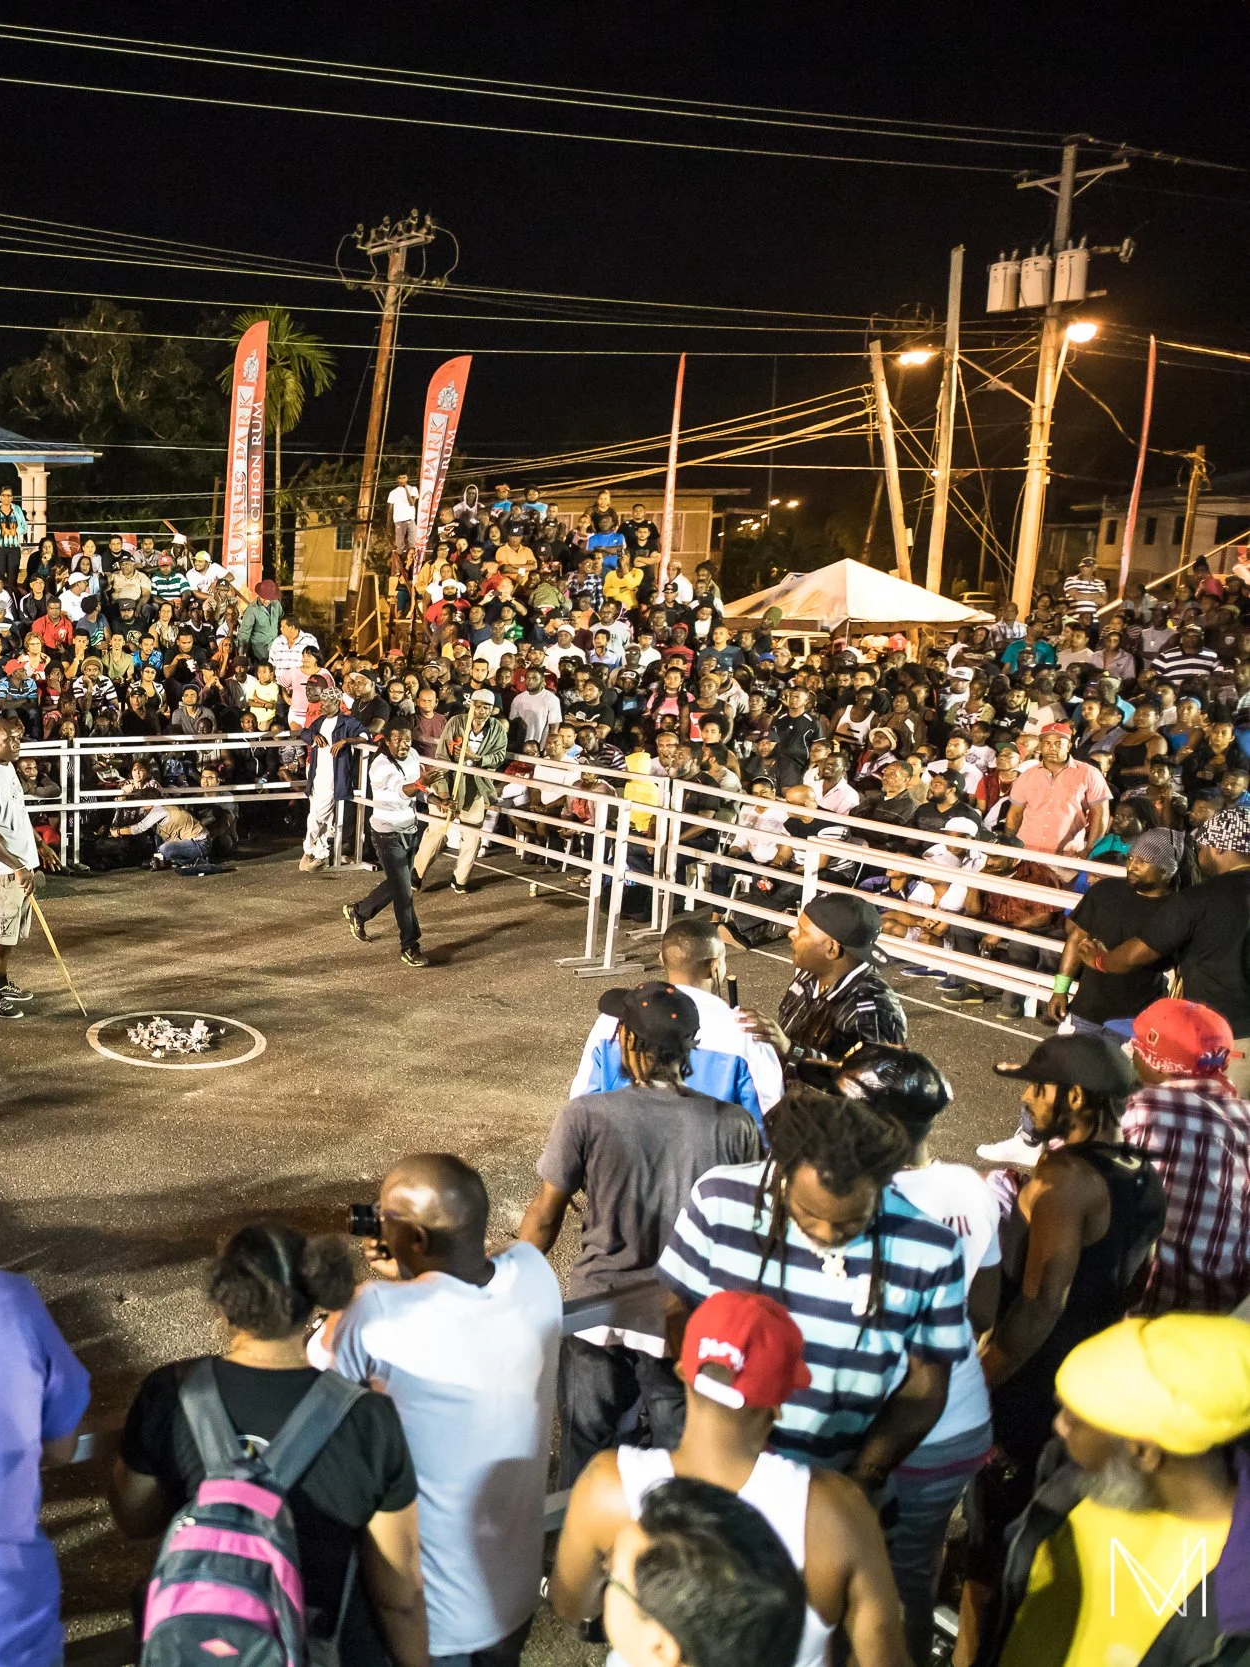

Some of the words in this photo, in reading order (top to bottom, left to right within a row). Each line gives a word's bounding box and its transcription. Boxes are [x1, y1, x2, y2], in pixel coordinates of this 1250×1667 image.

[236, 391, 253, 460] PARK
[251, 401, 263, 446] RUM
[424, 417, 445, 480] PARK
[441, 429, 457, 470] RUM
[250, 455, 262, 559] PUCHEON
